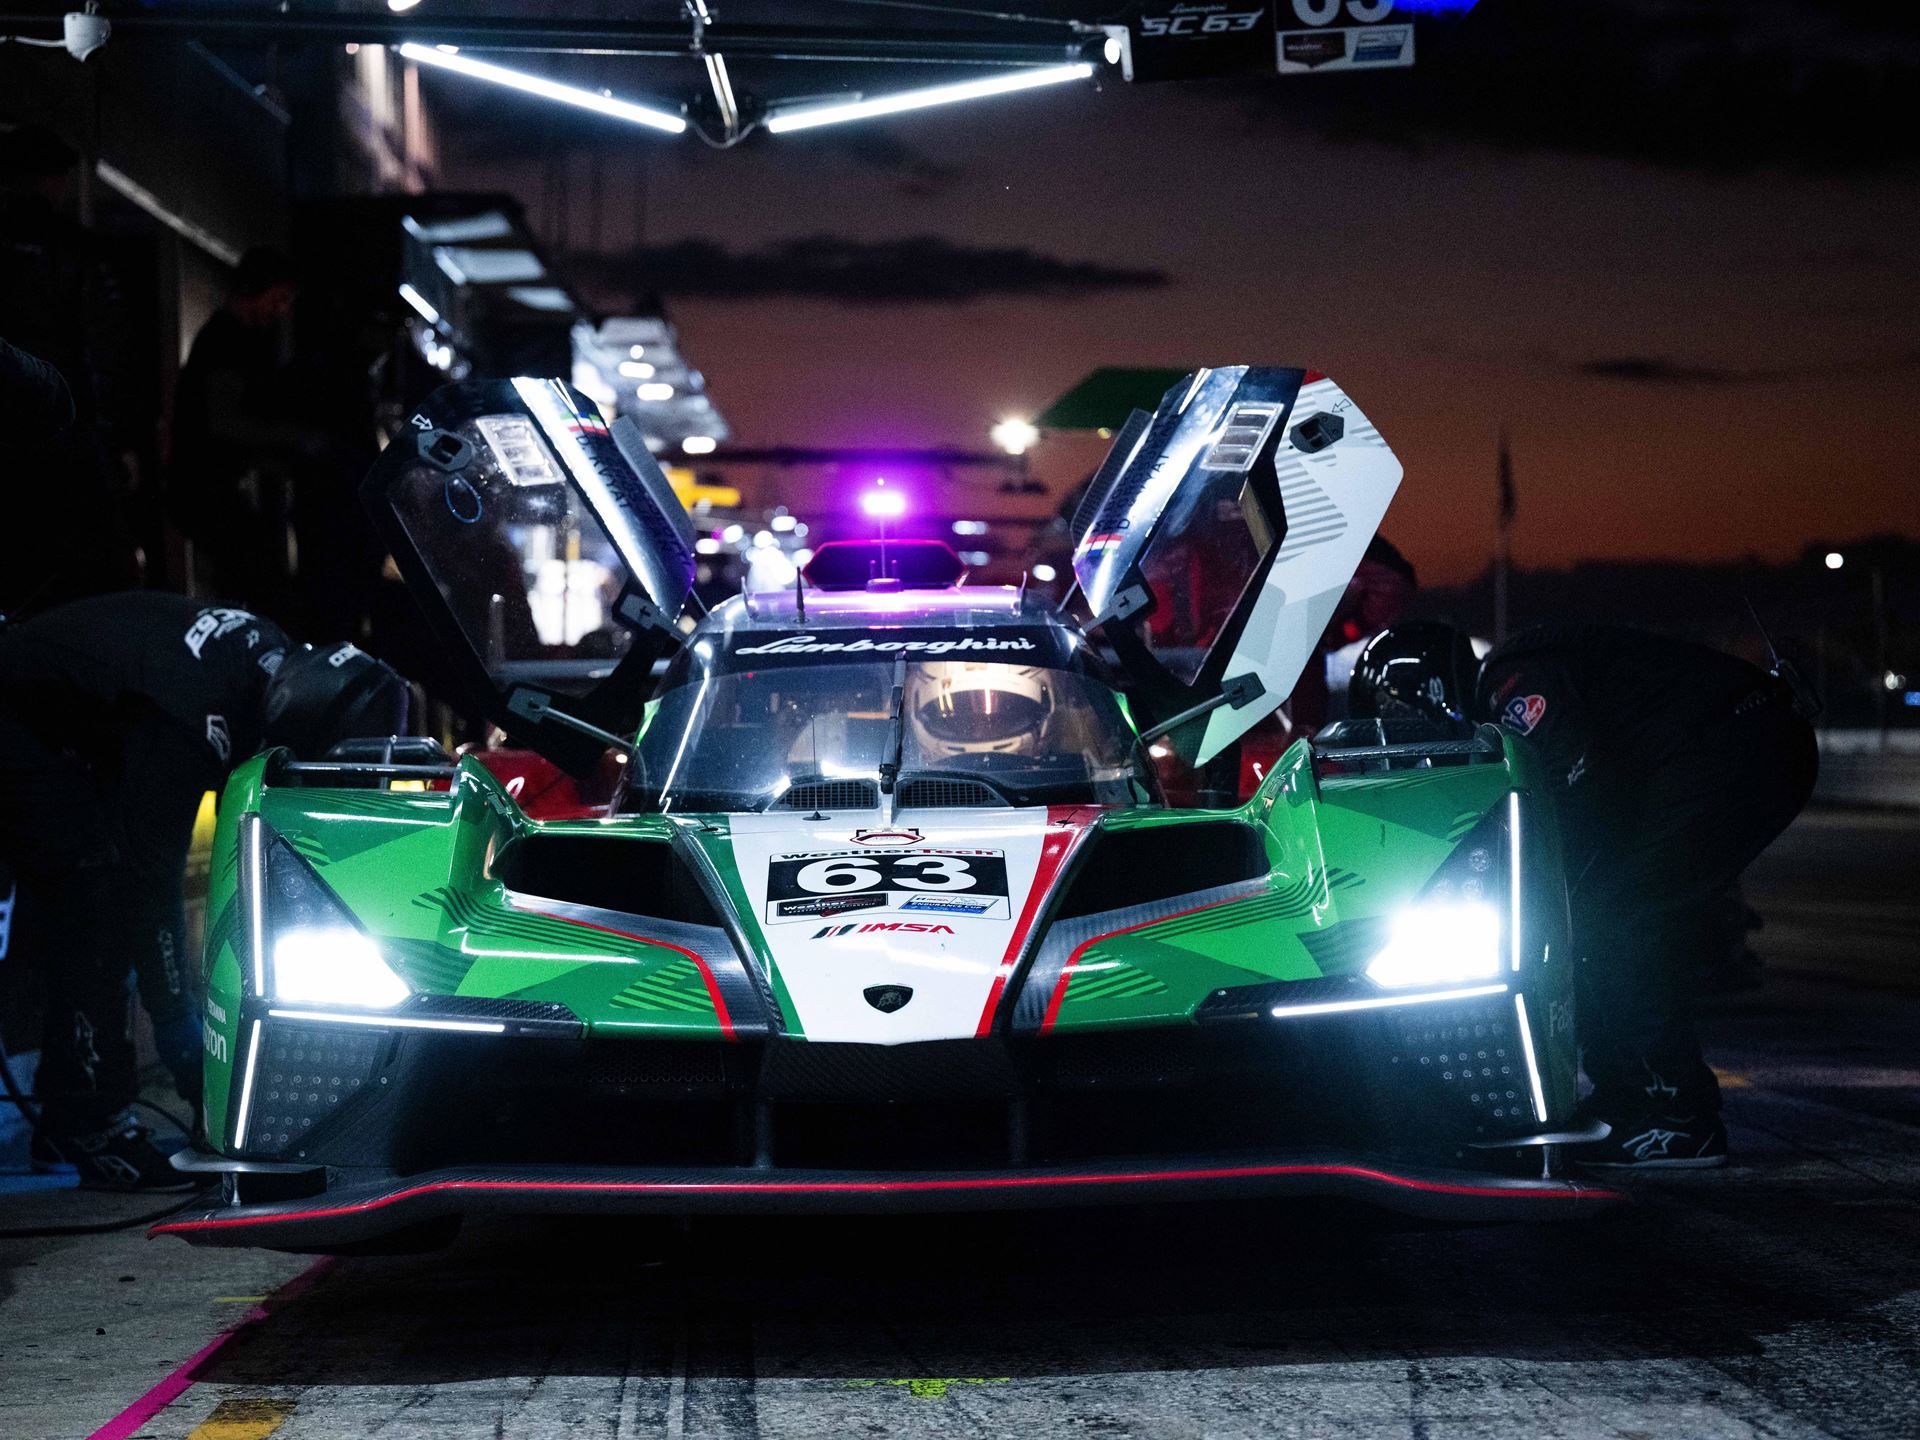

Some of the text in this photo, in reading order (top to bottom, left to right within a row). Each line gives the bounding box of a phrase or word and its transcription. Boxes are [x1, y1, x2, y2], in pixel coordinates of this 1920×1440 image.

[735, 635, 1036, 655] Lamborghini
[781, 848, 997, 860] WeatherTech
[797, 855, 978, 893] 63
[857, 923, 955, 935] IMSA
